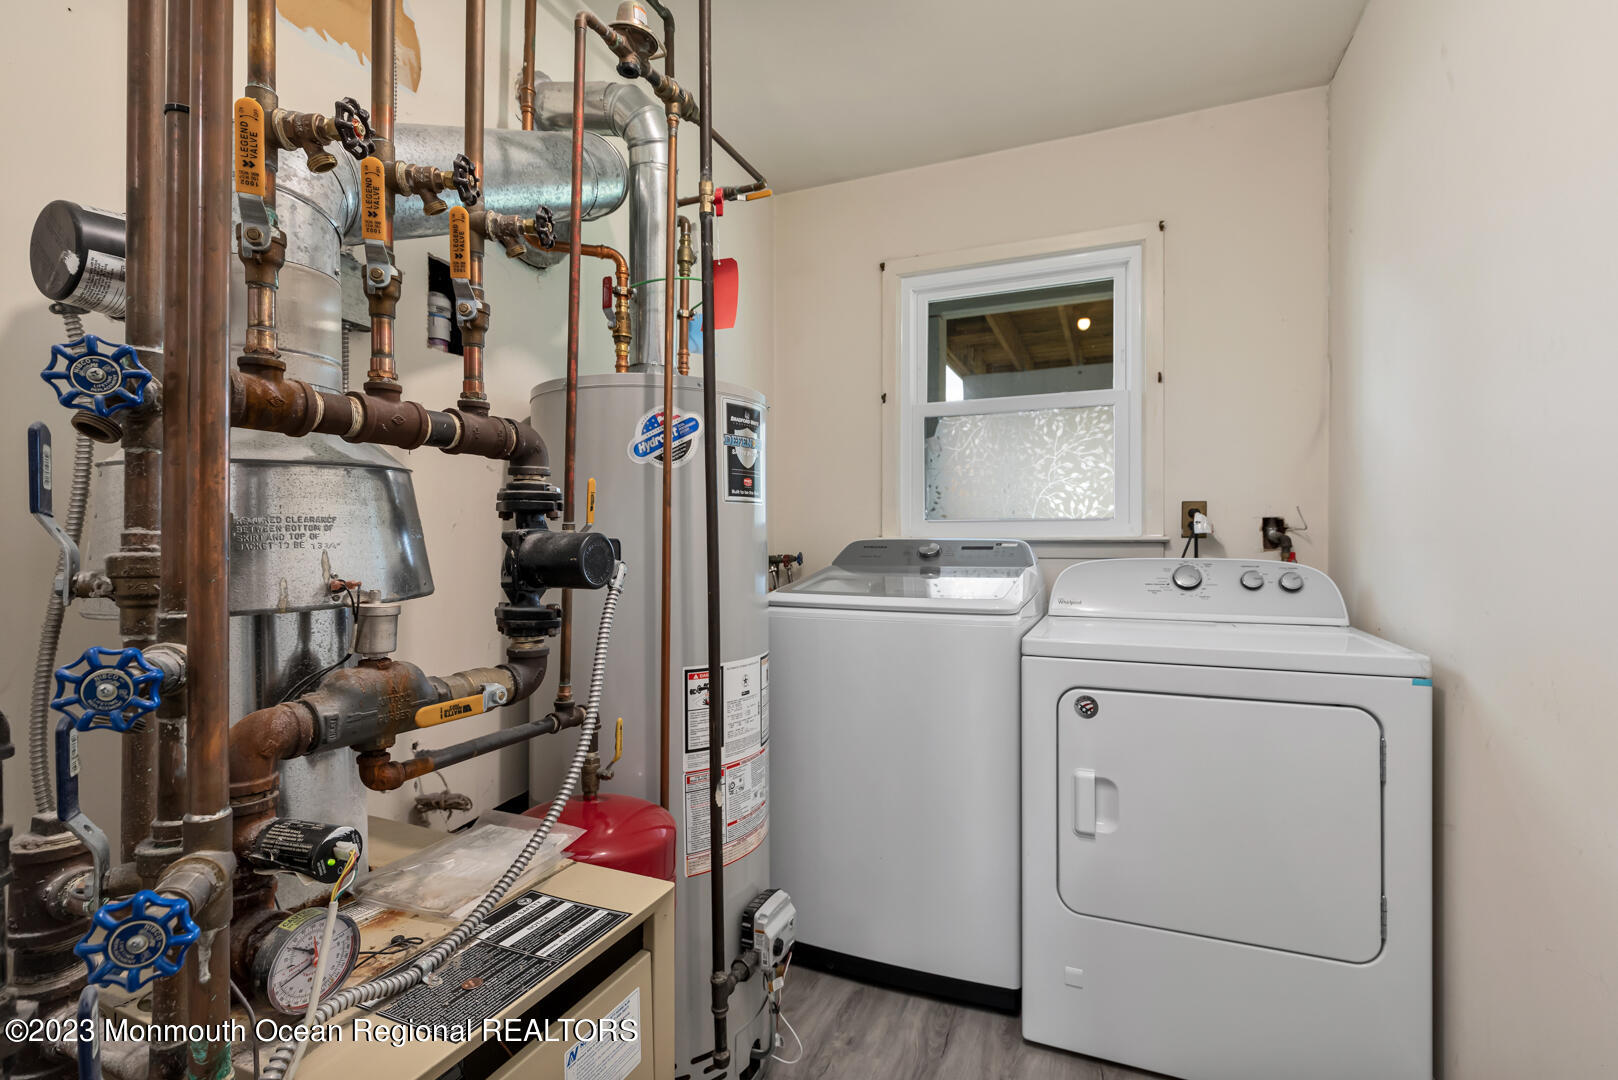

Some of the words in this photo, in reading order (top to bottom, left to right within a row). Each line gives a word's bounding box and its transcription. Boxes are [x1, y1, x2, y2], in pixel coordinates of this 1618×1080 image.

[240, 121, 249, 158] LEGEND
[250, 134, 258, 160] VALVE
[285, 524, 320, 532] BOTTOM
[324, 524, 334, 532] OF
[266, 534, 285, 542] AND
[294, 542, 305, 550] BE
[486, 922, 501, 934] FOR
[500, 912, 519, 928] YOUR
[518, 900, 543, 917] SAFETY
[526, 915, 550, 932] NOTICE
